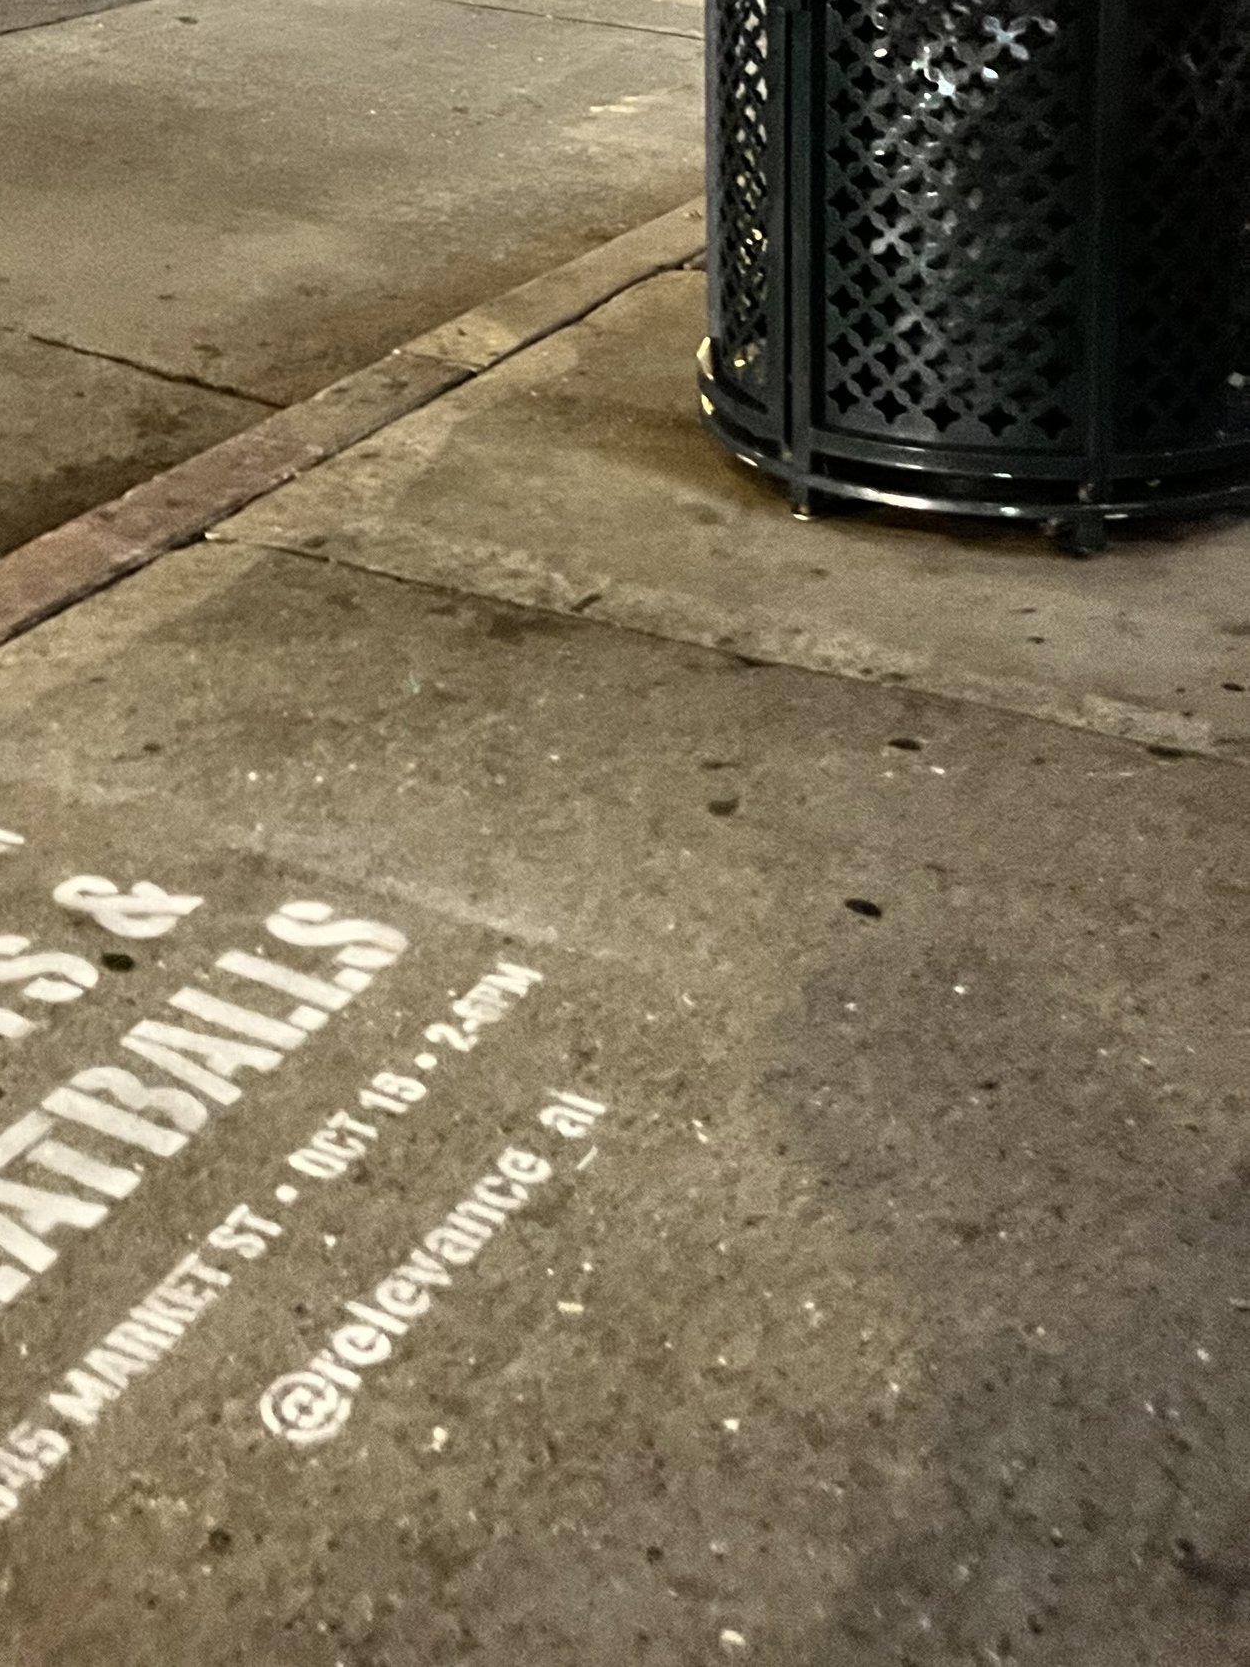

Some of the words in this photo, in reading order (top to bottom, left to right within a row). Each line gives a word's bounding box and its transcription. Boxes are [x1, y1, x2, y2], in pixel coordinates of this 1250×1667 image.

[54, 875, 205, 938] &
[49, 1252, 233, 1425] MARKET
[207, 1202, 283, 1259] ST
[288, 1109, 379, 1178] OCT
